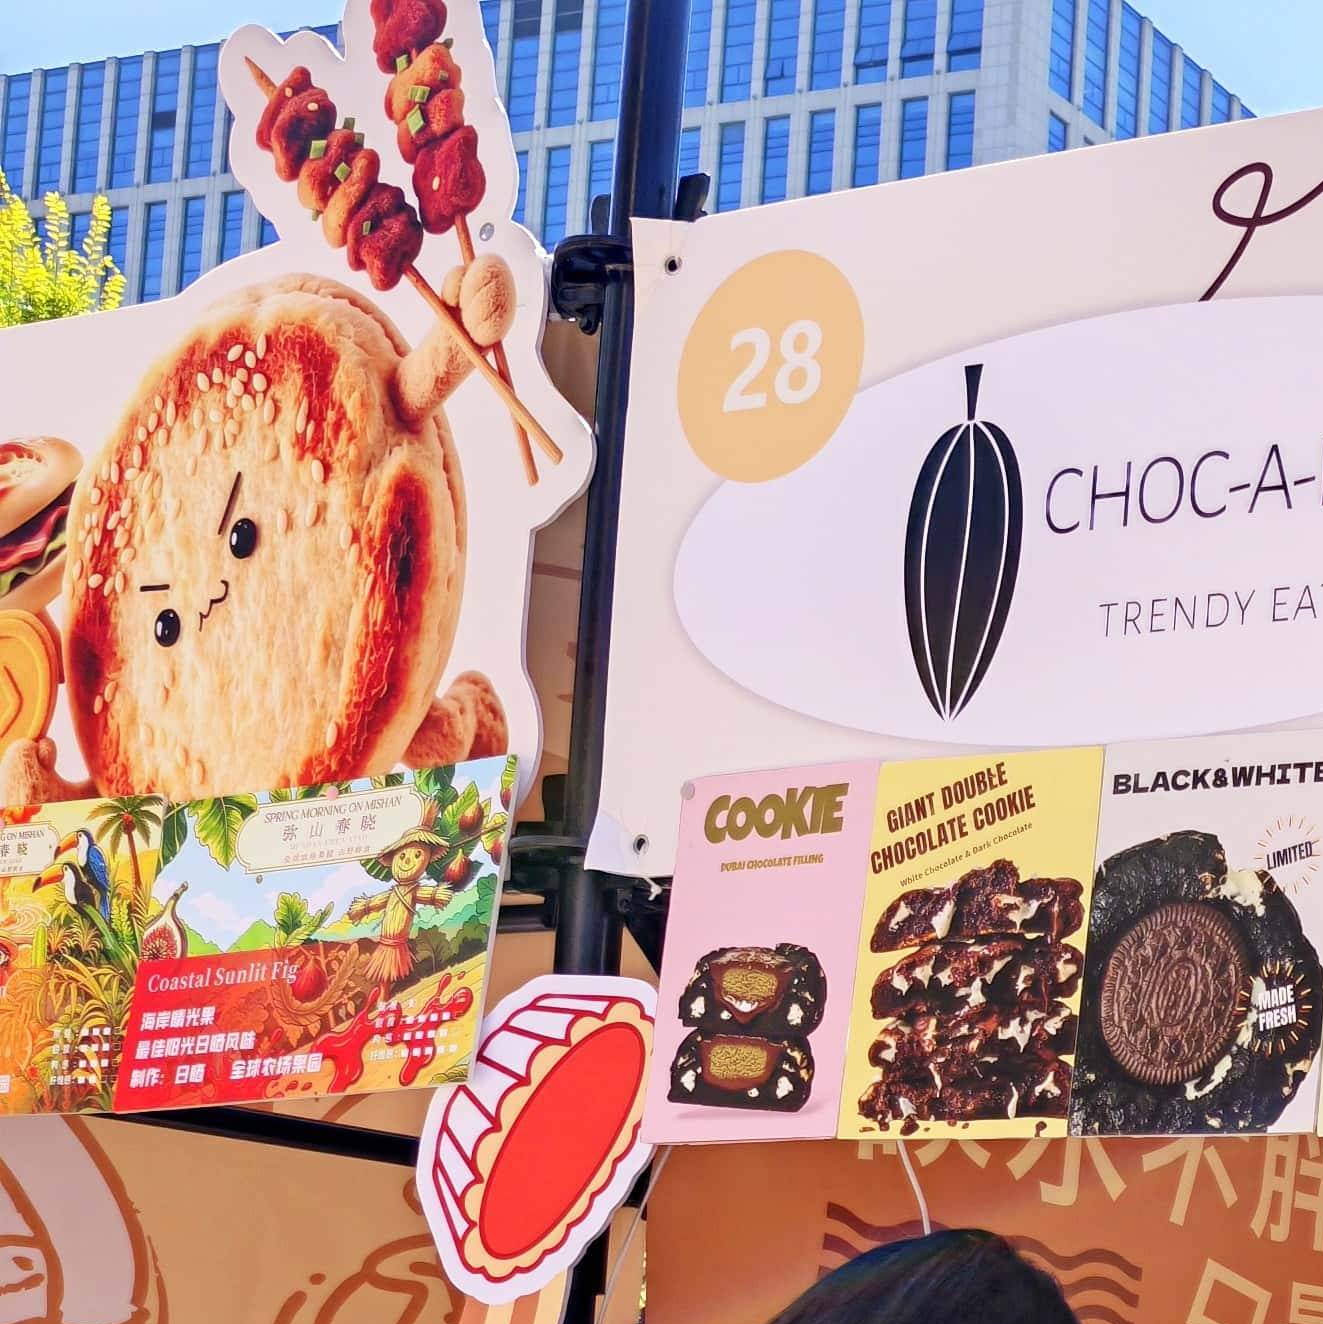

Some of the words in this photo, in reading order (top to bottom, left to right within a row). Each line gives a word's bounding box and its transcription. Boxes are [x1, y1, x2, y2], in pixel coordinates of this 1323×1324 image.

[721, 320, 823, 412] 28
[1099, 589, 1256, 638] TRENDY
[264, 809, 299, 824] SPRING
[301, 804, 348, 819] MORNING
[349, 801, 364, 812] ON
[365, 795, 403, 811] MISHAN
[704, 783, 850, 844] COOKIE
[886, 792, 936, 833] GIANT
[941, 761, 1008, 811] DOUBLE
[870, 814, 969, 875] CHOCOLATE
[972, 785, 1036, 831] COOKIE
[720, 861, 745, 872] DUBAI
[746, 856, 792, 870] CHOCOLATE
[793, 853, 824, 865] FILLING
[900, 872, 923, 887] White
[925, 854, 963, 876] Chocolate
[973, 840, 991, 855] Dark
[993, 822, 1033, 844] Chocolate
[1266, 840, 1313, 871] LIMITED
[148, 968, 210, 993] Coastal
[214, 963, 268, 987] Sunlit
[271, 959, 300, 984] Fig
[1257, 983, 1294, 1011] MADE
[1259, 1005, 1296, 1032] FRESH
